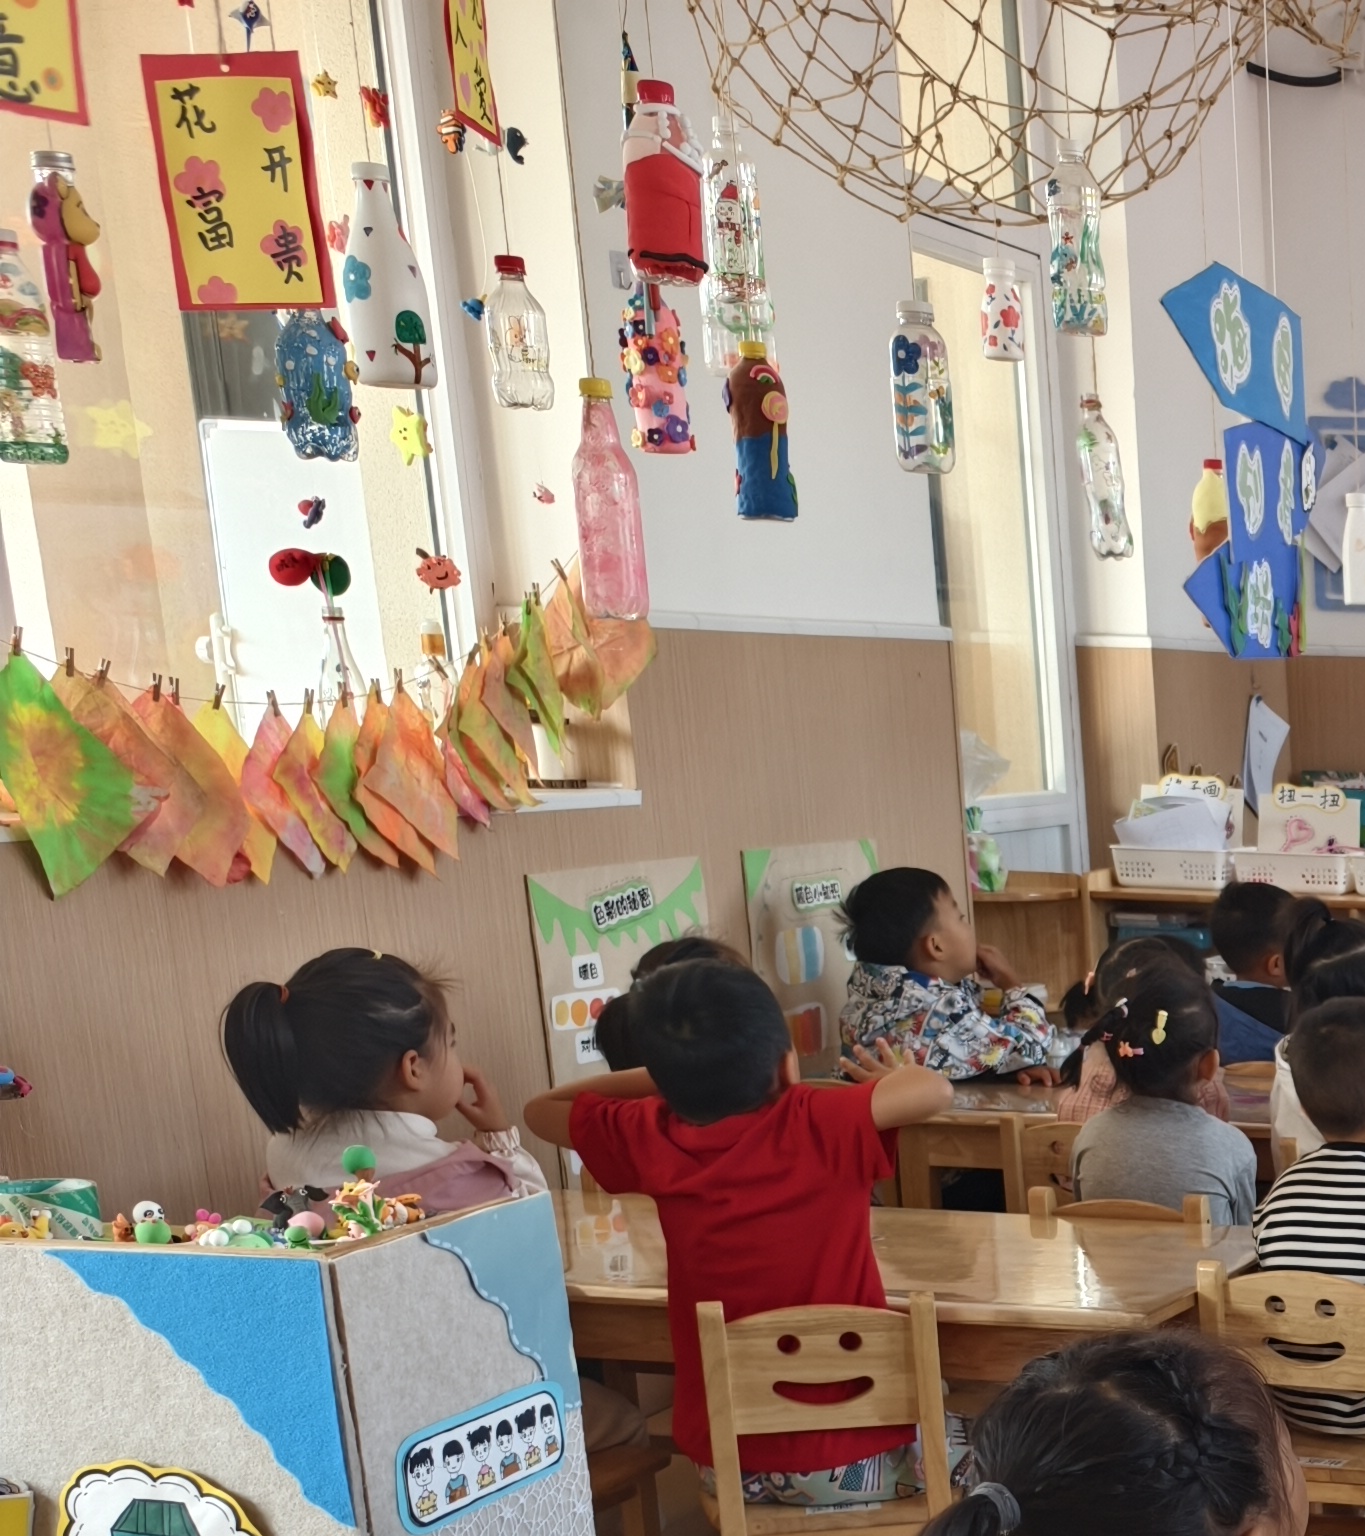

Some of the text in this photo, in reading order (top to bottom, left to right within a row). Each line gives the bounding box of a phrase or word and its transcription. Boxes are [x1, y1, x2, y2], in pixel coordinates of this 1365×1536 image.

[171, 84, 304, 284] 花 开 富 贵
[1278, 784, 1341, 810] 扭一扭
